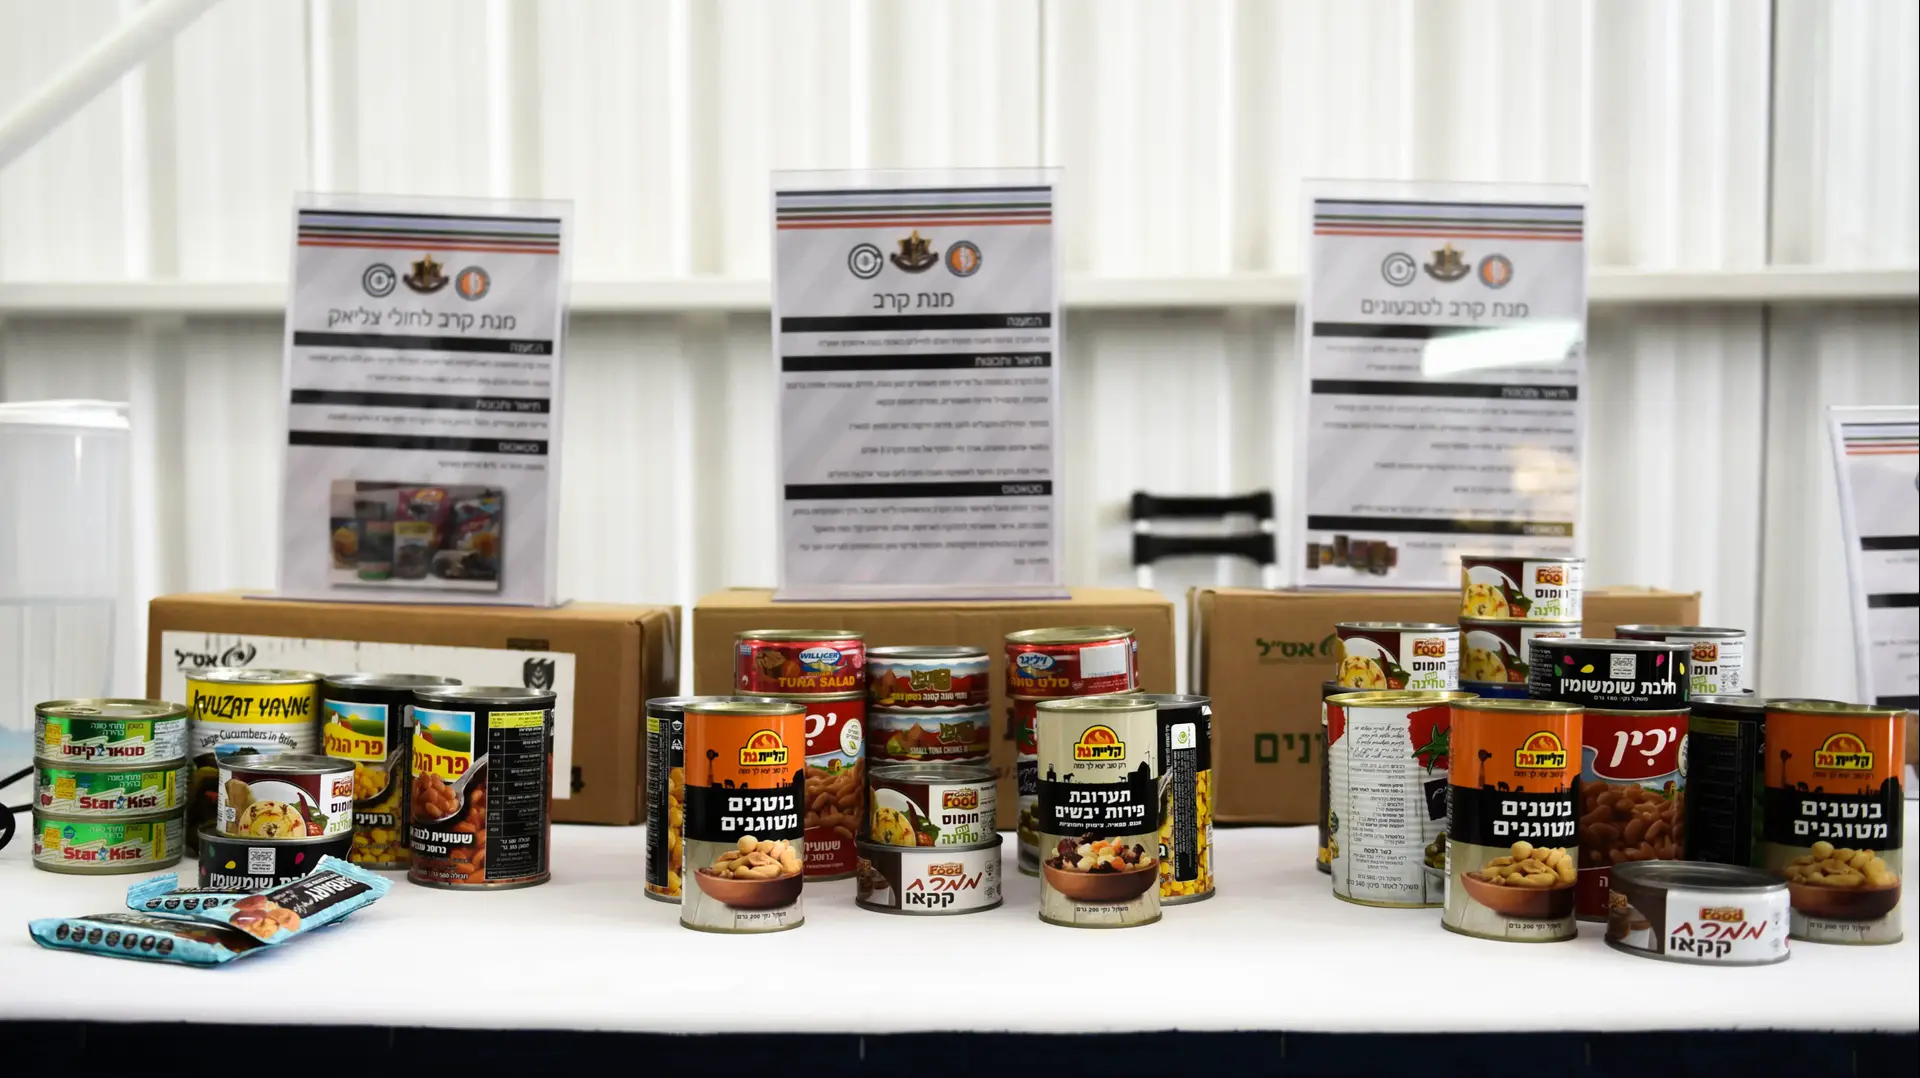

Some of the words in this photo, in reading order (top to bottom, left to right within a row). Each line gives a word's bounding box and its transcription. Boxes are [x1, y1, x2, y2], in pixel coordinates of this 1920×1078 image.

[873, 293, 910, 312] קרב
[917, 292, 954, 308] מנת
[1361, 297, 1442, 316] לטבעונים
[327, 307, 381, 327] צליאק
[388, 307, 433, 328] לחולי
[1449, 301, 1485, 320] קרב
[1492, 302, 1529, 318] מנת
[438, 312, 474, 332] קרב
[479, 314, 517, 330] מנת
[1414, 641, 1445, 655] Food
[1413, 661, 1446, 671] חומוס
[778, 677, 815, 688] TUNA
[819, 676, 855, 687] SALAD
[1038, 675, 1069, 687] סלט
[1412, 679, 1445, 689] טחינה
[1561, 678, 1635, 695] שומשומין
[1641, 676, 1676, 695] חלבת
[193, 689, 254, 721] KVUZAT
[259, 696, 311, 719] YAVNE
[200, 733, 219, 748] Large
[219, 728, 267, 740] Cucumbers
[268, 731, 277, 741] in
[279, 733, 298, 749] Brine
[63, 742, 95, 760] קיסט
[106, 746, 145, 756] סטאר
[355, 740, 384, 755] פרי
[1077, 746, 1091, 757] גת
[1092, 745, 1122, 757] קליית
[743, 751, 757, 763] גת
[758, 750, 785, 762] קליית
[1519, 753, 1534, 765] גת
[1536, 753, 1564, 766] קליית
[1818, 754, 1834, 765] גת
[1836, 754, 1870, 768] קליית
[436, 756, 469, 774] פרי
[80, 796, 117, 809] Star
[127, 794, 157, 808] Kist
[728, 795, 794, 812] בוטנים
[943, 792, 978, 808] Food
[1069, 790, 1131, 804] תערובת
[1055, 805, 1100, 819] יבשים
[1104, 804, 1145, 819] פירות
[1501, 800, 1571, 817] בוטנים
[1802, 800, 1882, 818] בוטנים
[356, 812, 392, 825] גרעיני
[721, 813, 798, 831] מטוגנים
[942, 812, 979, 825] חומוס
[1493, 820, 1575, 838] מטוגנים
[1794, 820, 1888, 838] מטוגנים
[432, 832, 472, 844] שעועית
[942, 831, 978, 844] טחינה
[64, 847, 98, 860] Star
[109, 846, 142, 860] Kist
[929, 864, 963, 876] Food
[210, 872, 274, 889] שומשומין
[905, 891, 954, 908] קקאו
[1701, 909, 1743, 921] Food
[1671, 936, 1732, 958] קקאו
